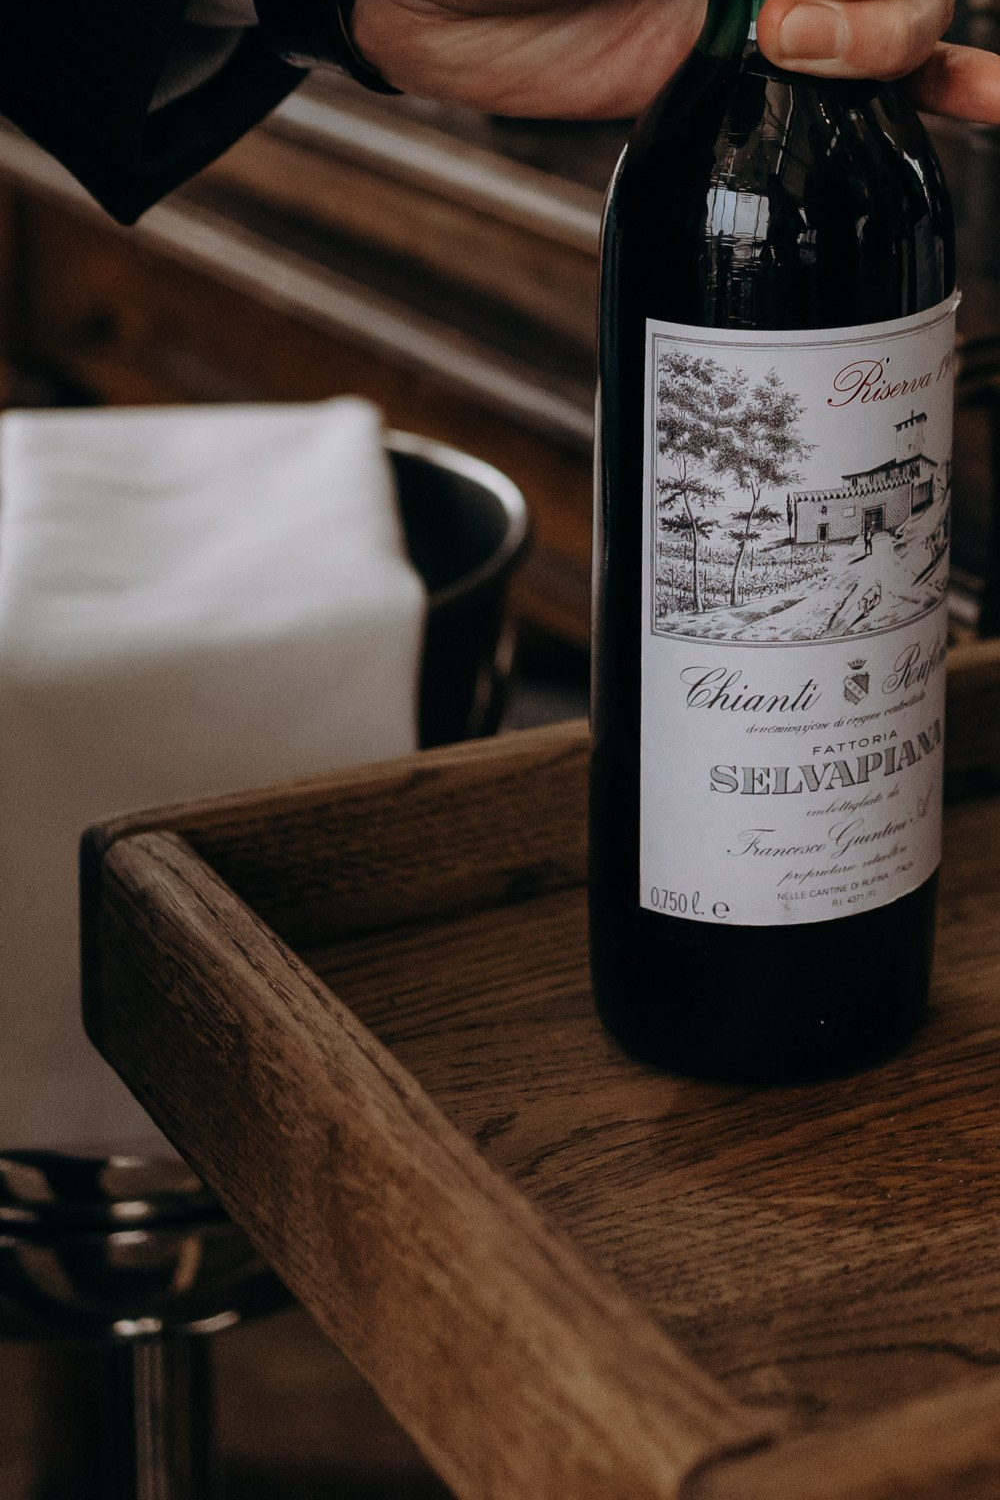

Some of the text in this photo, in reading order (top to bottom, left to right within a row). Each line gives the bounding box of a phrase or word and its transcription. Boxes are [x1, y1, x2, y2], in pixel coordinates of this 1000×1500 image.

[827, 357, 933, 407] Riserva
[680, 665, 824, 713] Chianti
[745, 718, 831, 737] denominazione
[833, 716, 845, 727] di
[846, 711, 882, 728] origine
[812, 729, 898, 756] FATTORIA
[727, 828, 827, 858] Francesco
[650, 886, 688, 914] 0,750
[776, 890, 807, 902] NELLE
[808, 883, 849, 899] CANTINE
[850, 881, 860, 892] DI
